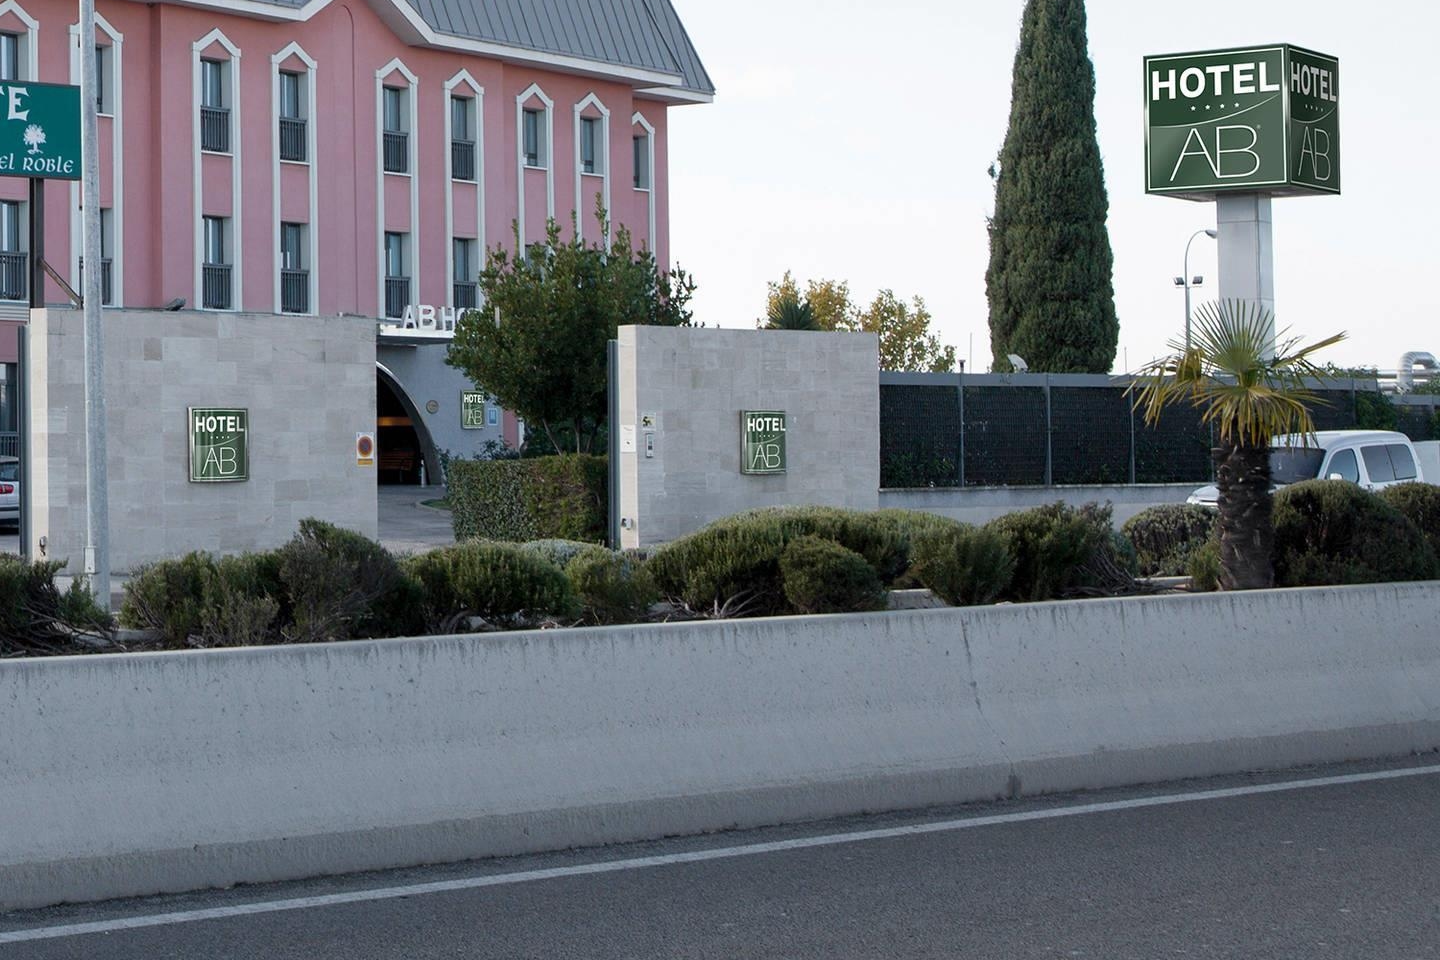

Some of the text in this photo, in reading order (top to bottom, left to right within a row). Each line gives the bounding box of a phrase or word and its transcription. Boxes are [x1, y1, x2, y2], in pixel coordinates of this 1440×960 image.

[1152, 62, 1281, 101] HOTEL
[1290, 61, 1337, 103] HOTEL
[1169, 124, 1261, 182] AB
[1297, 125, 1332, 182] AB
[402, 304, 437, 331] AB
[464, 394, 485, 403] HOTEL
[195, 415, 244, 433] HOTEL
[466, 410, 483, 425] AB
[747, 417, 786, 432] HOTEL
[202, 446, 237, 475] AB
[751, 443, 781, 468] AB
